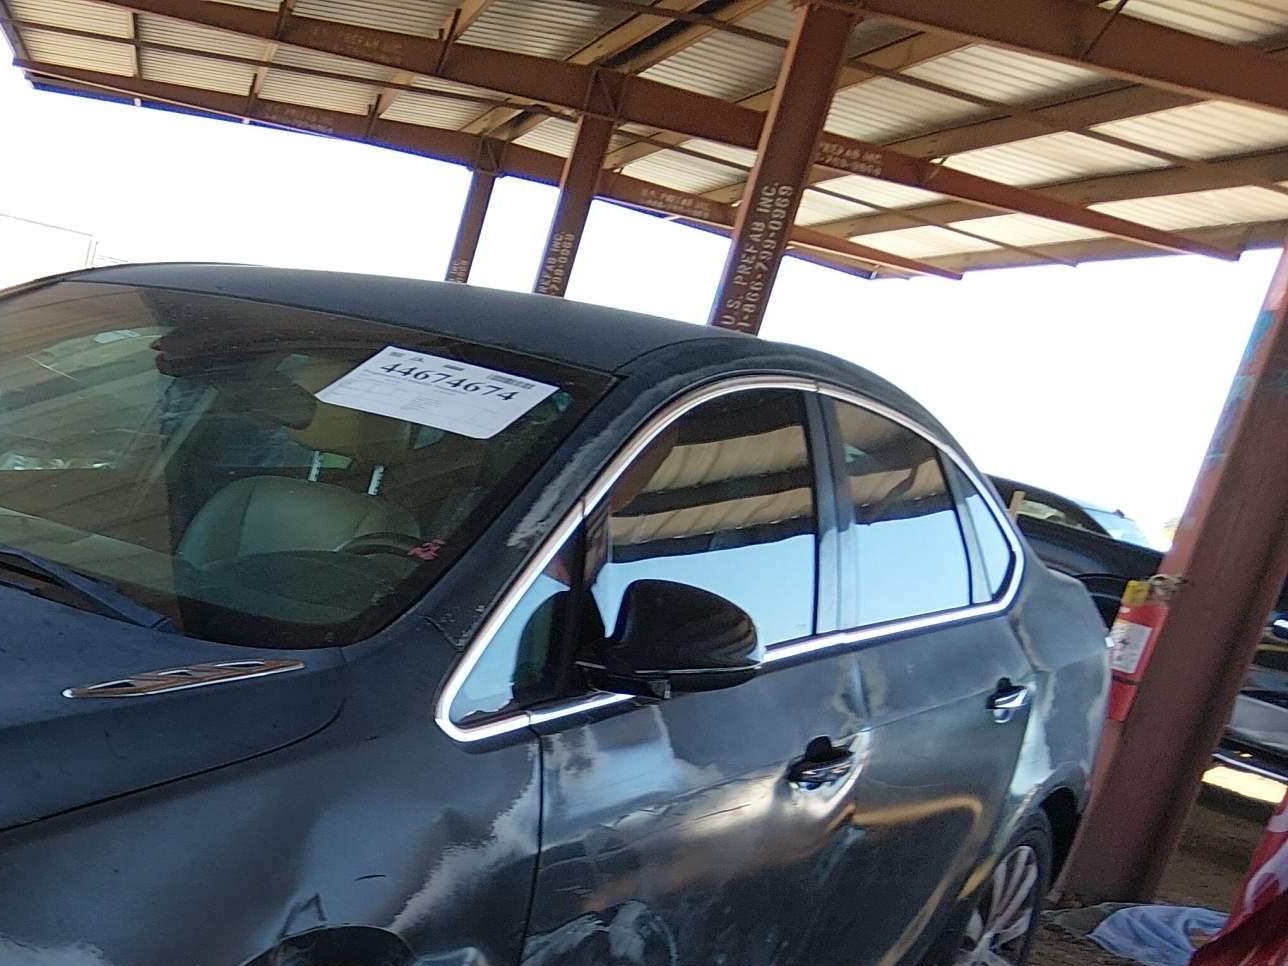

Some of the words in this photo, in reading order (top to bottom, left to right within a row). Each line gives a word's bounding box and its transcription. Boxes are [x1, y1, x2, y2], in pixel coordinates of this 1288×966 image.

[720, 295, 745, 326] U.S.
[734, 221, 766, 286] PREFAB
[756, 182, 779, 213] INC.
[380, 363, 520, 401] 44674674
